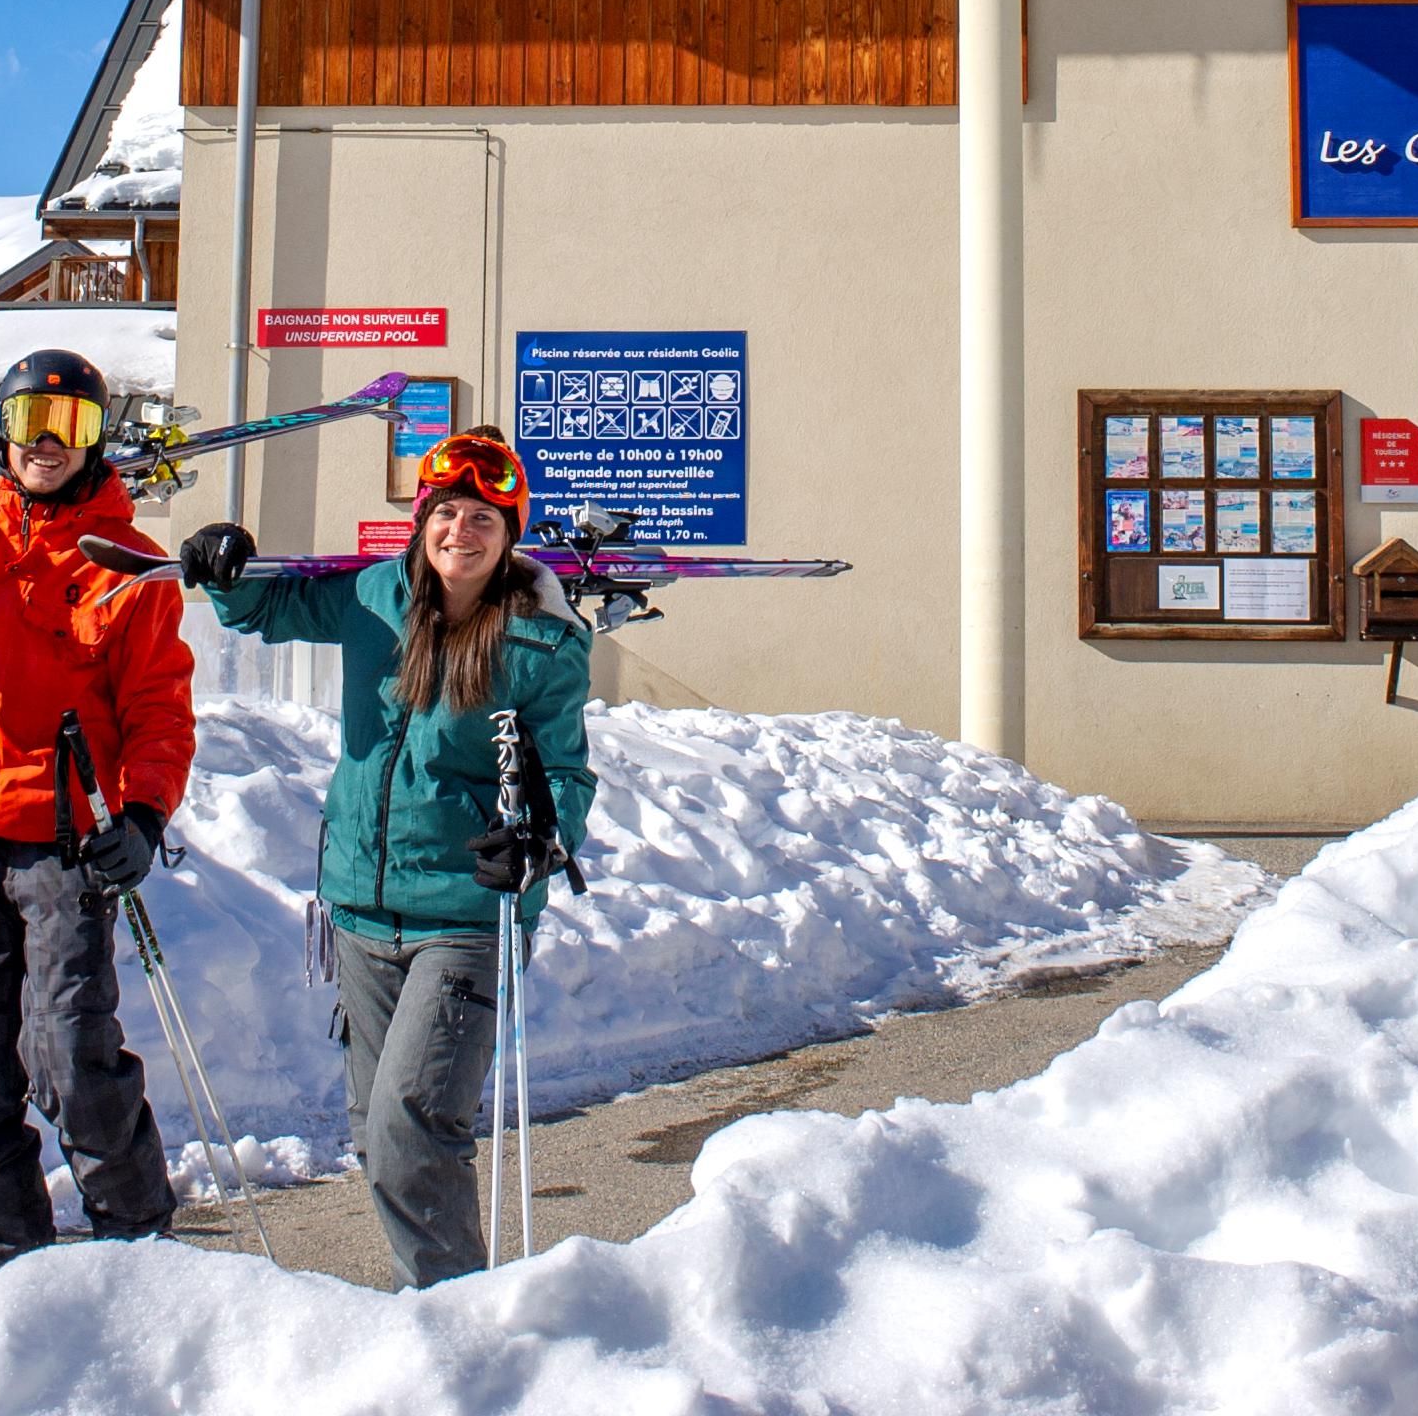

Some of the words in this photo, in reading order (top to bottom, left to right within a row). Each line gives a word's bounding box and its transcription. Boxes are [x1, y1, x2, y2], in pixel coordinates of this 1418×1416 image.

[1319, 130, 1386, 165] Les
[264, 314, 330, 326] BAIGNADE
[332, 314, 360, 326] NON
[362, 312, 439, 325] SURVEILLÉE
[285, 331, 382, 343] UNSUPERVISED
[383, 331, 419, 342] POOL
[531, 348, 570, 358] Piscine
[572, 348, 621, 358] réservée
[623, 350, 645, 358] aux
[647, 348, 699, 358] résidents
[701, 347, 740, 358] Goélia
[536, 450, 593, 461] Ouverte
[596, 450, 614, 461] de
[619, 449, 662, 461] 10h00
[665, 449, 676, 461] à
[680, 450, 723, 461] 19h00
[544, 467, 613, 480] Baignade
[616, 469, 643, 478] non
[646, 466, 715, 479] surveillée
[571, 481, 618, 490] swimming
[619, 481, 636, 489] not
[637, 480, 688, 490] supervised
[712, 492, 740, 500] parents
[633, 504, 658, 516] des
[662, 504, 714, 516] bassins
[656, 518, 684, 528] depth
[634, 529, 662, 540] Maxi
[665, 530, 691, 541] 1,70
[693, 531, 708, 540] m.
